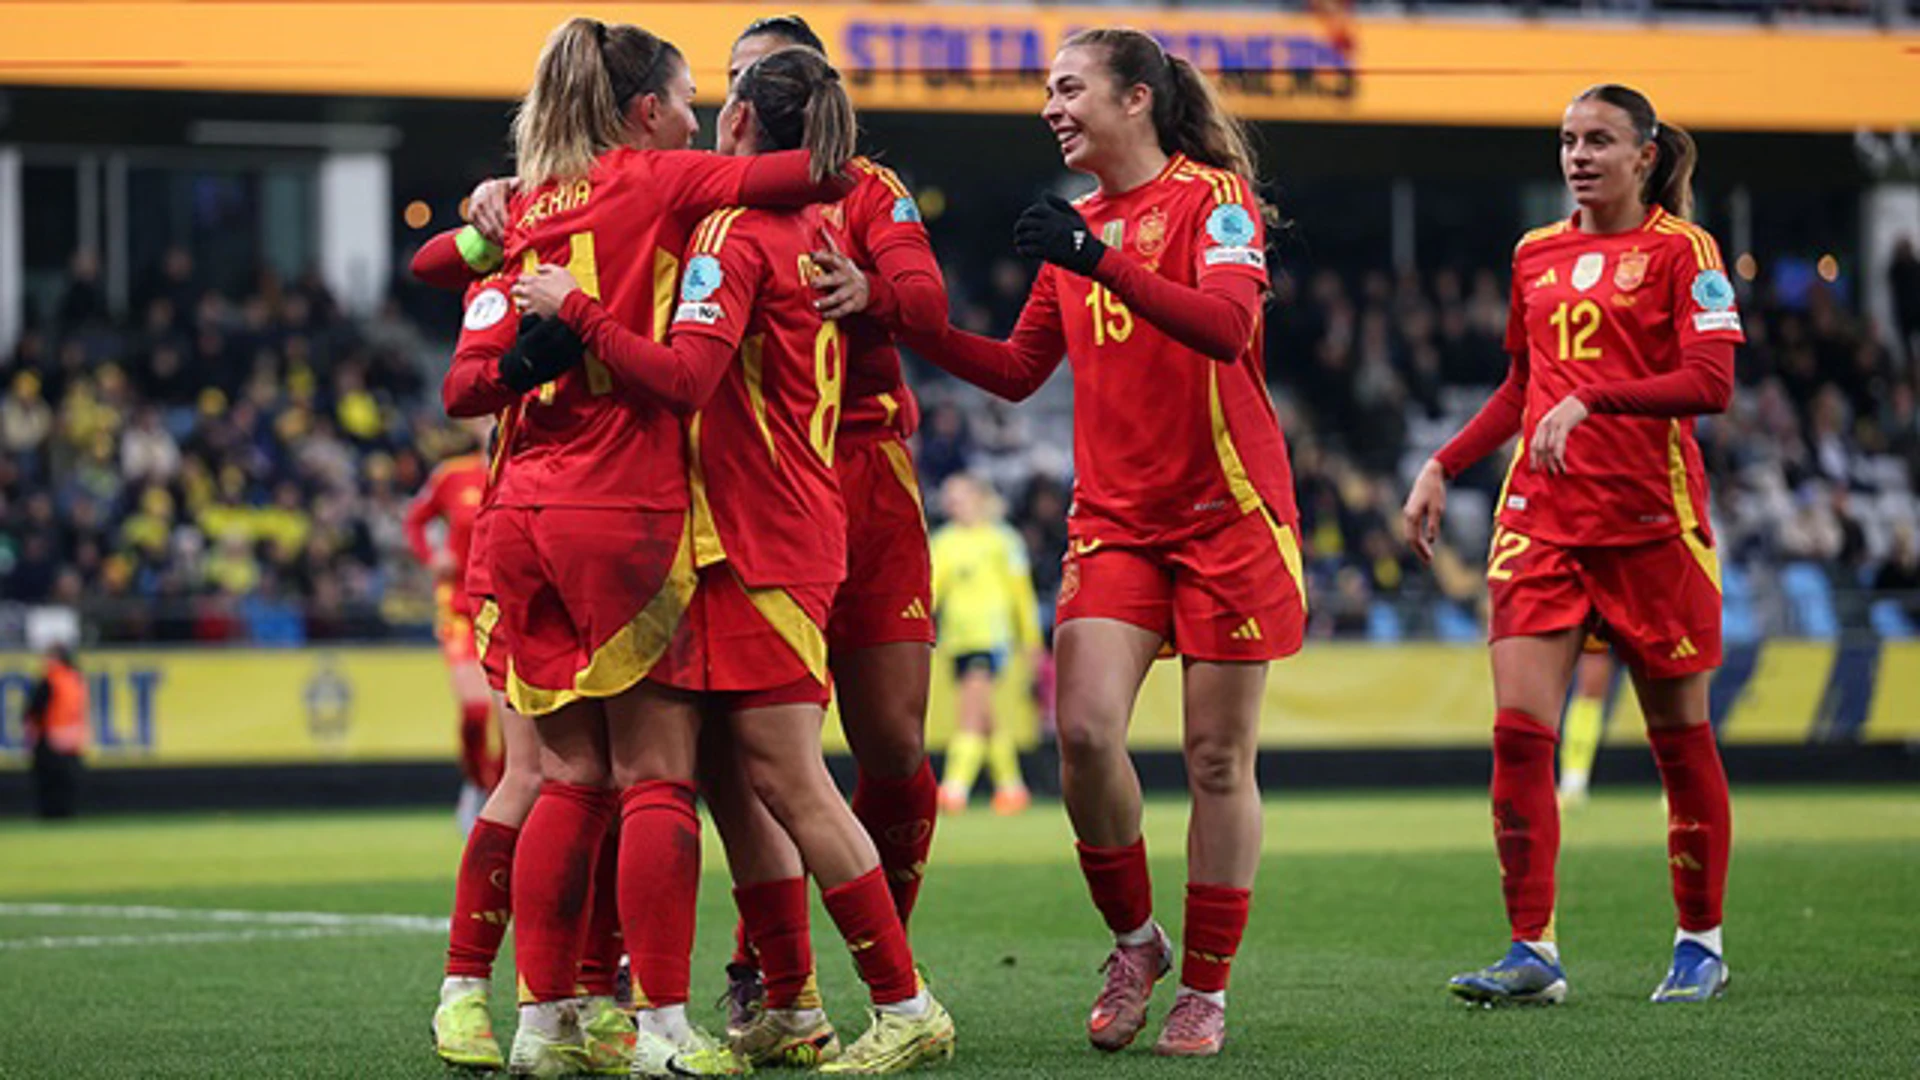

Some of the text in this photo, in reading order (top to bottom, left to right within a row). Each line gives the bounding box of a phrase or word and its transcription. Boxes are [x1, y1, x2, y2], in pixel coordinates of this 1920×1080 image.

[1086, 281, 1134, 346] 15
[1549, 299, 1603, 362] 12
[809, 319, 842, 469] 8
